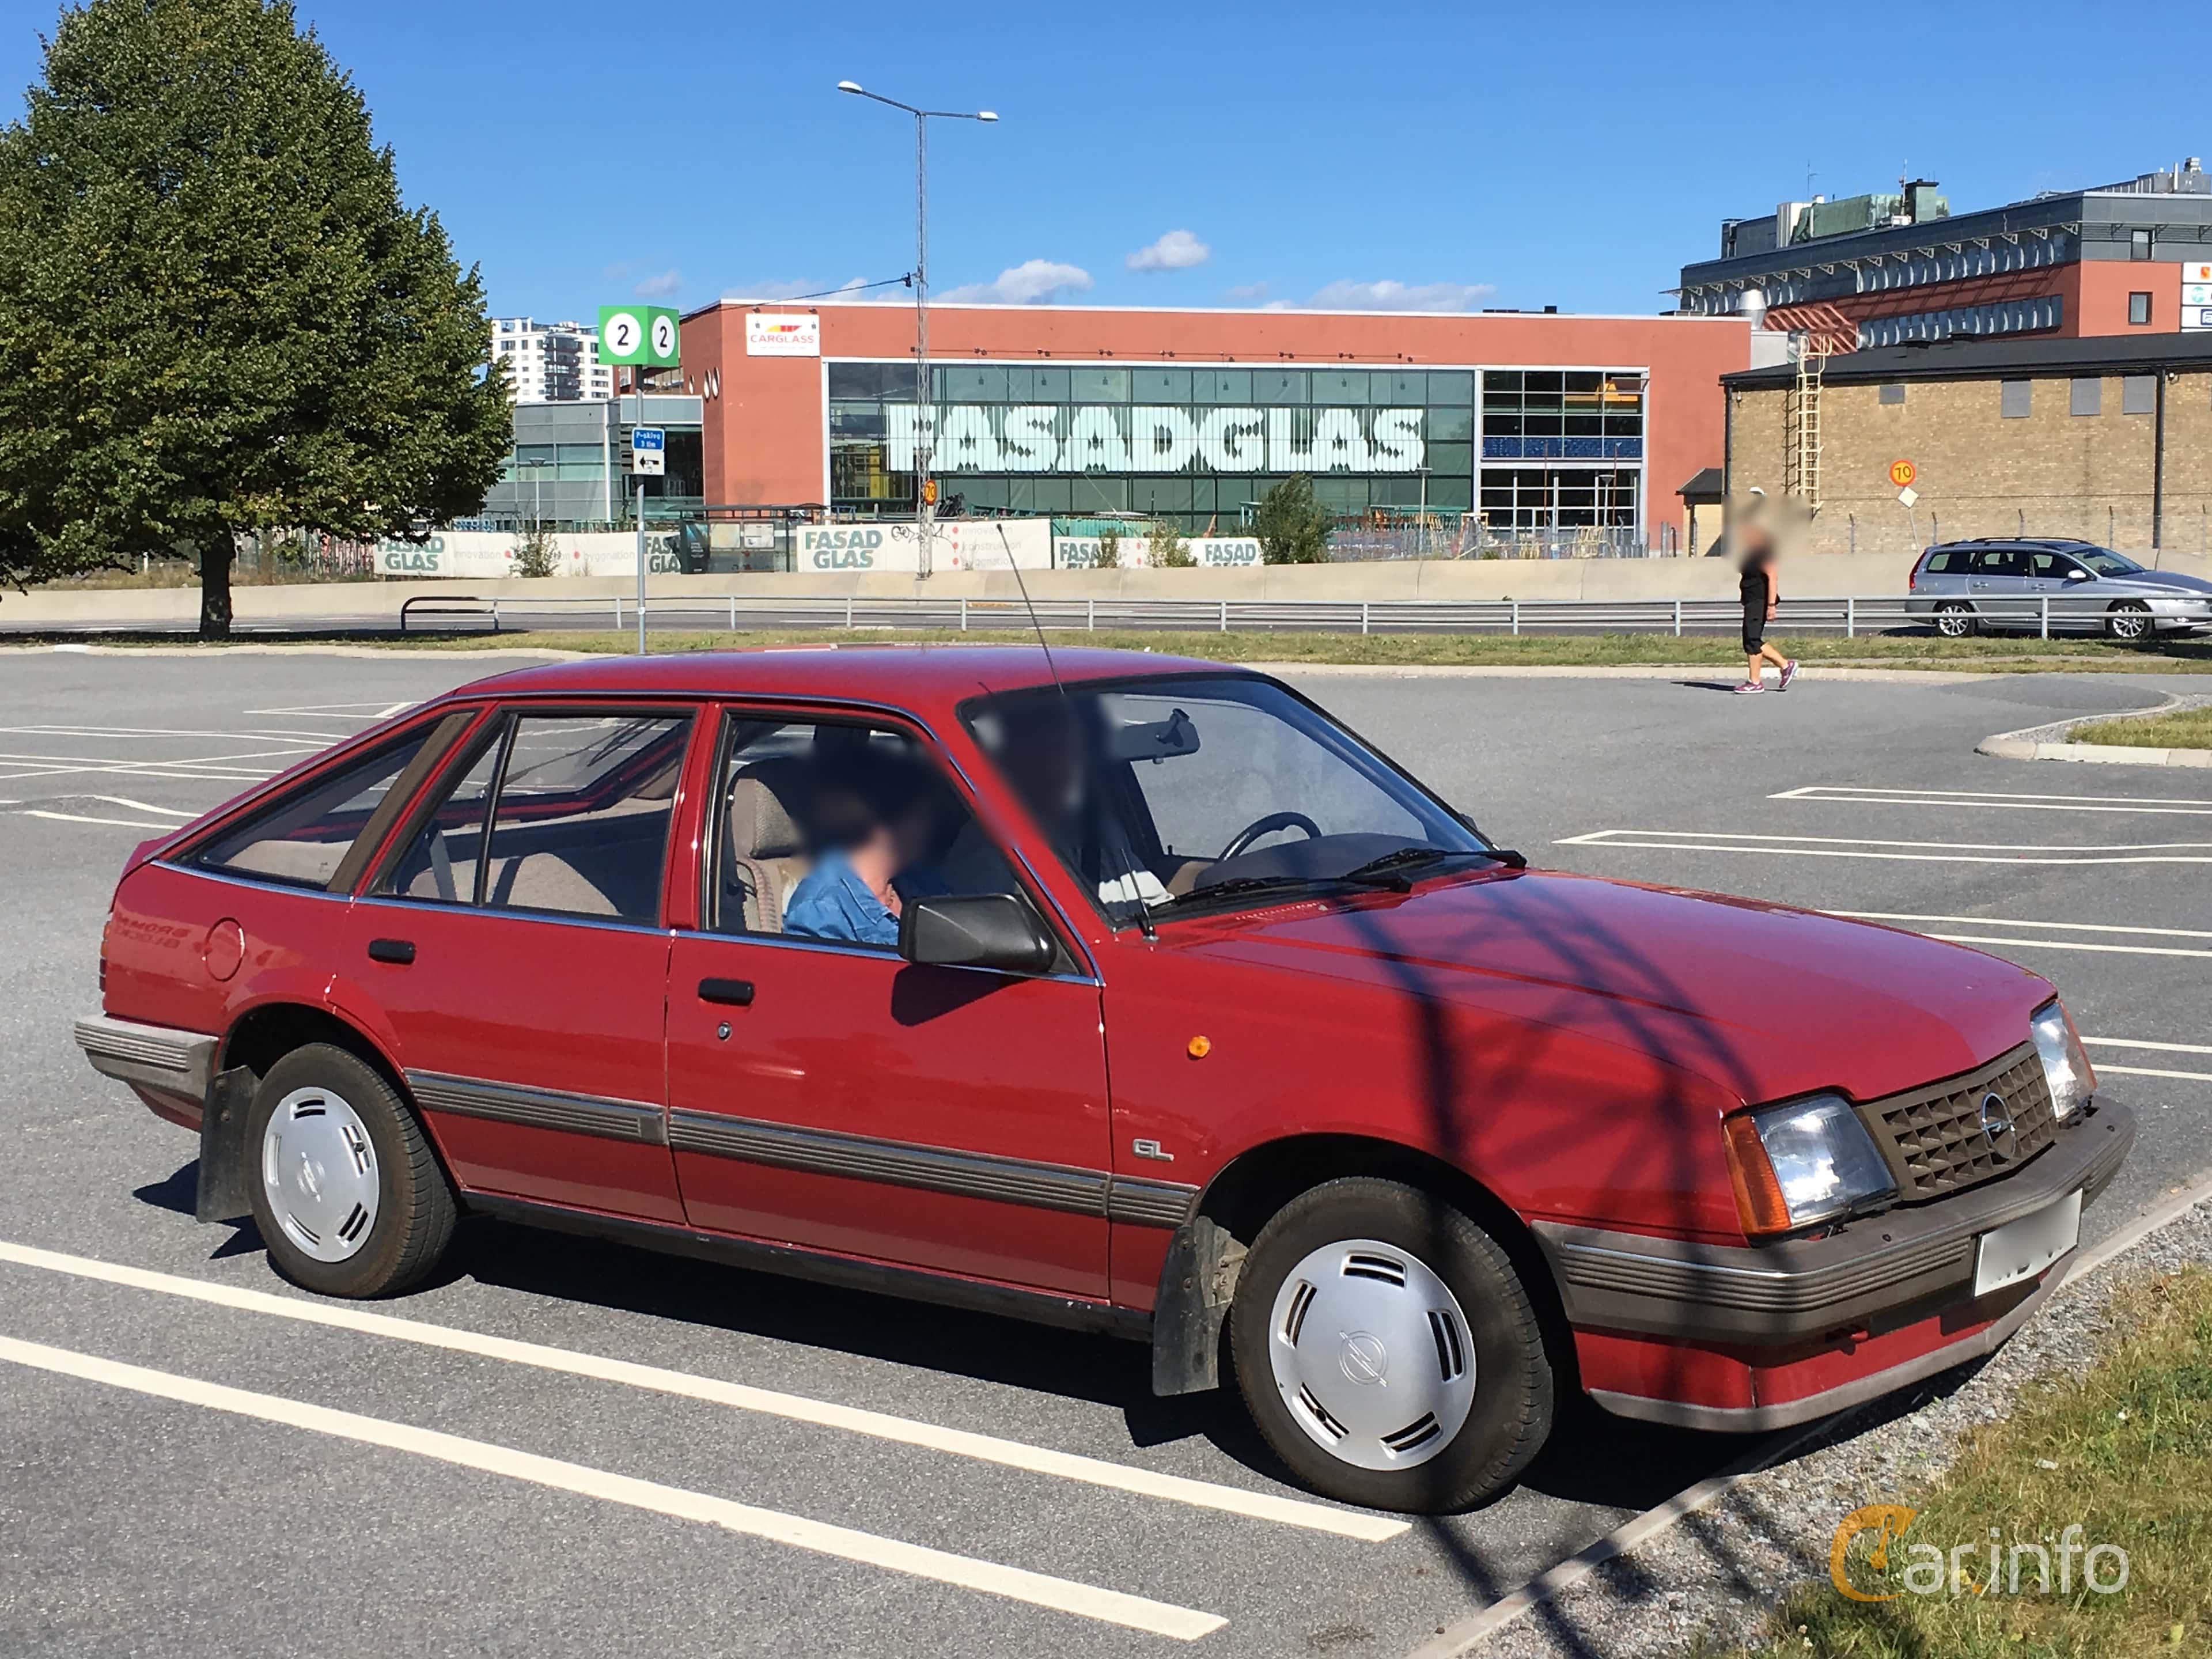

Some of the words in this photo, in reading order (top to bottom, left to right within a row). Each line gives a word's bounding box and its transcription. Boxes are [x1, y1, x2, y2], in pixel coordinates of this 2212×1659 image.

[618, 324, 629, 346] 2
[660, 325, 668, 348] 2
[750, 335, 815, 343] CARGLASS
[1895, 465, 1911, 480] 70
[805, 530, 883, 550] FASAD
[385, 553, 438, 571] GLAS
[813, 550, 874, 569] GLAS
[1205, 543, 1256, 562] FASAD
[649, 555, 682, 573] GLA
[1132, 1138, 1175, 1162] GL
